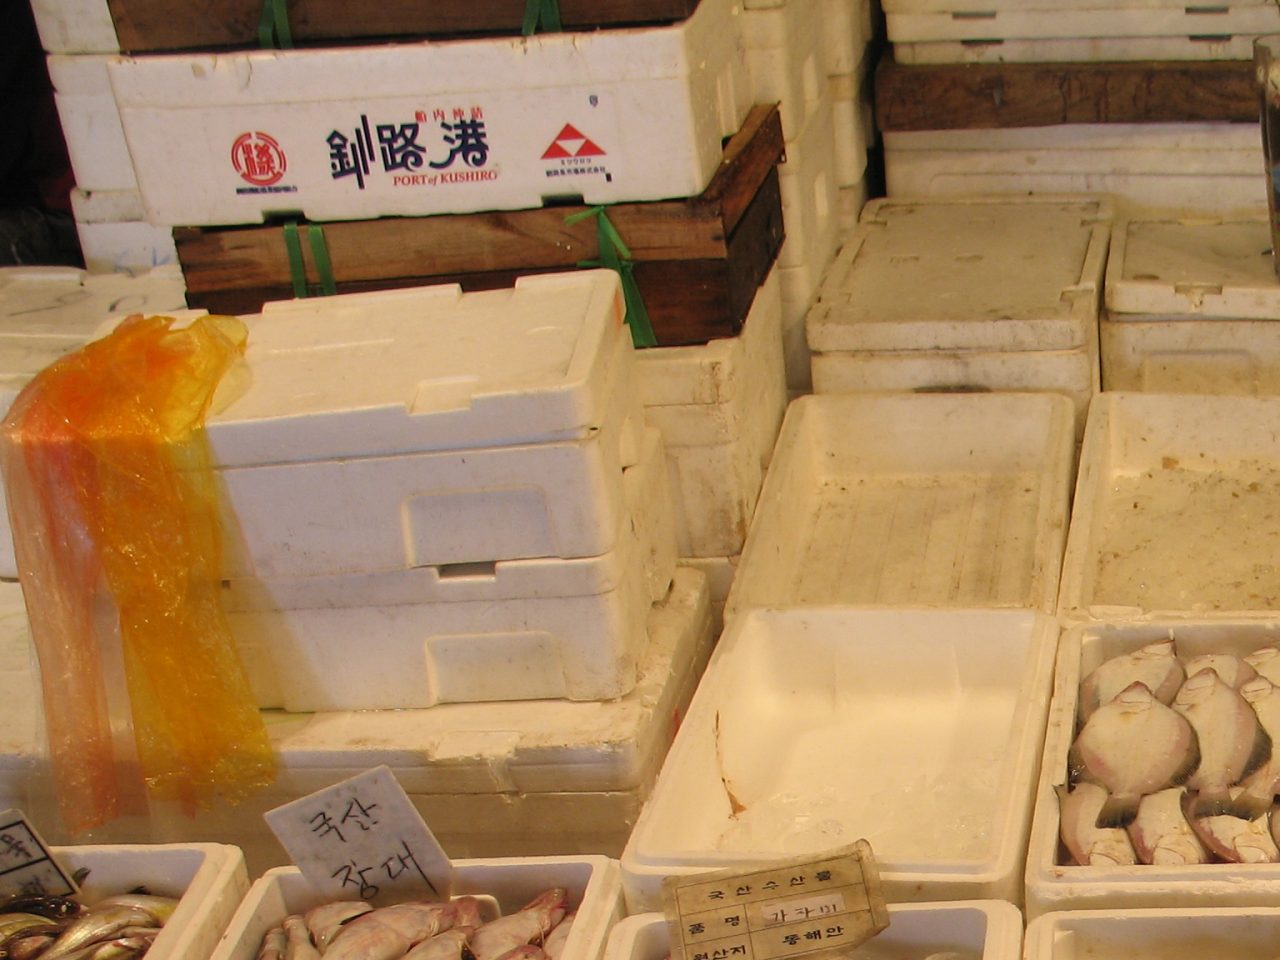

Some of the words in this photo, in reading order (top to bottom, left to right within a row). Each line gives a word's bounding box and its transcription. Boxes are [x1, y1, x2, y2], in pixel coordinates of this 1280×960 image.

[326, 114, 490, 190] 釧路港
[393, 174, 428, 186] PORT
[428, 174, 438, 186] of
[440, 170, 498, 184] KUSHIRO
[309, 797, 379, 843] 국산
[331, 840, 440, 900] 장대
[782, 925, 845, 946] 동해안
